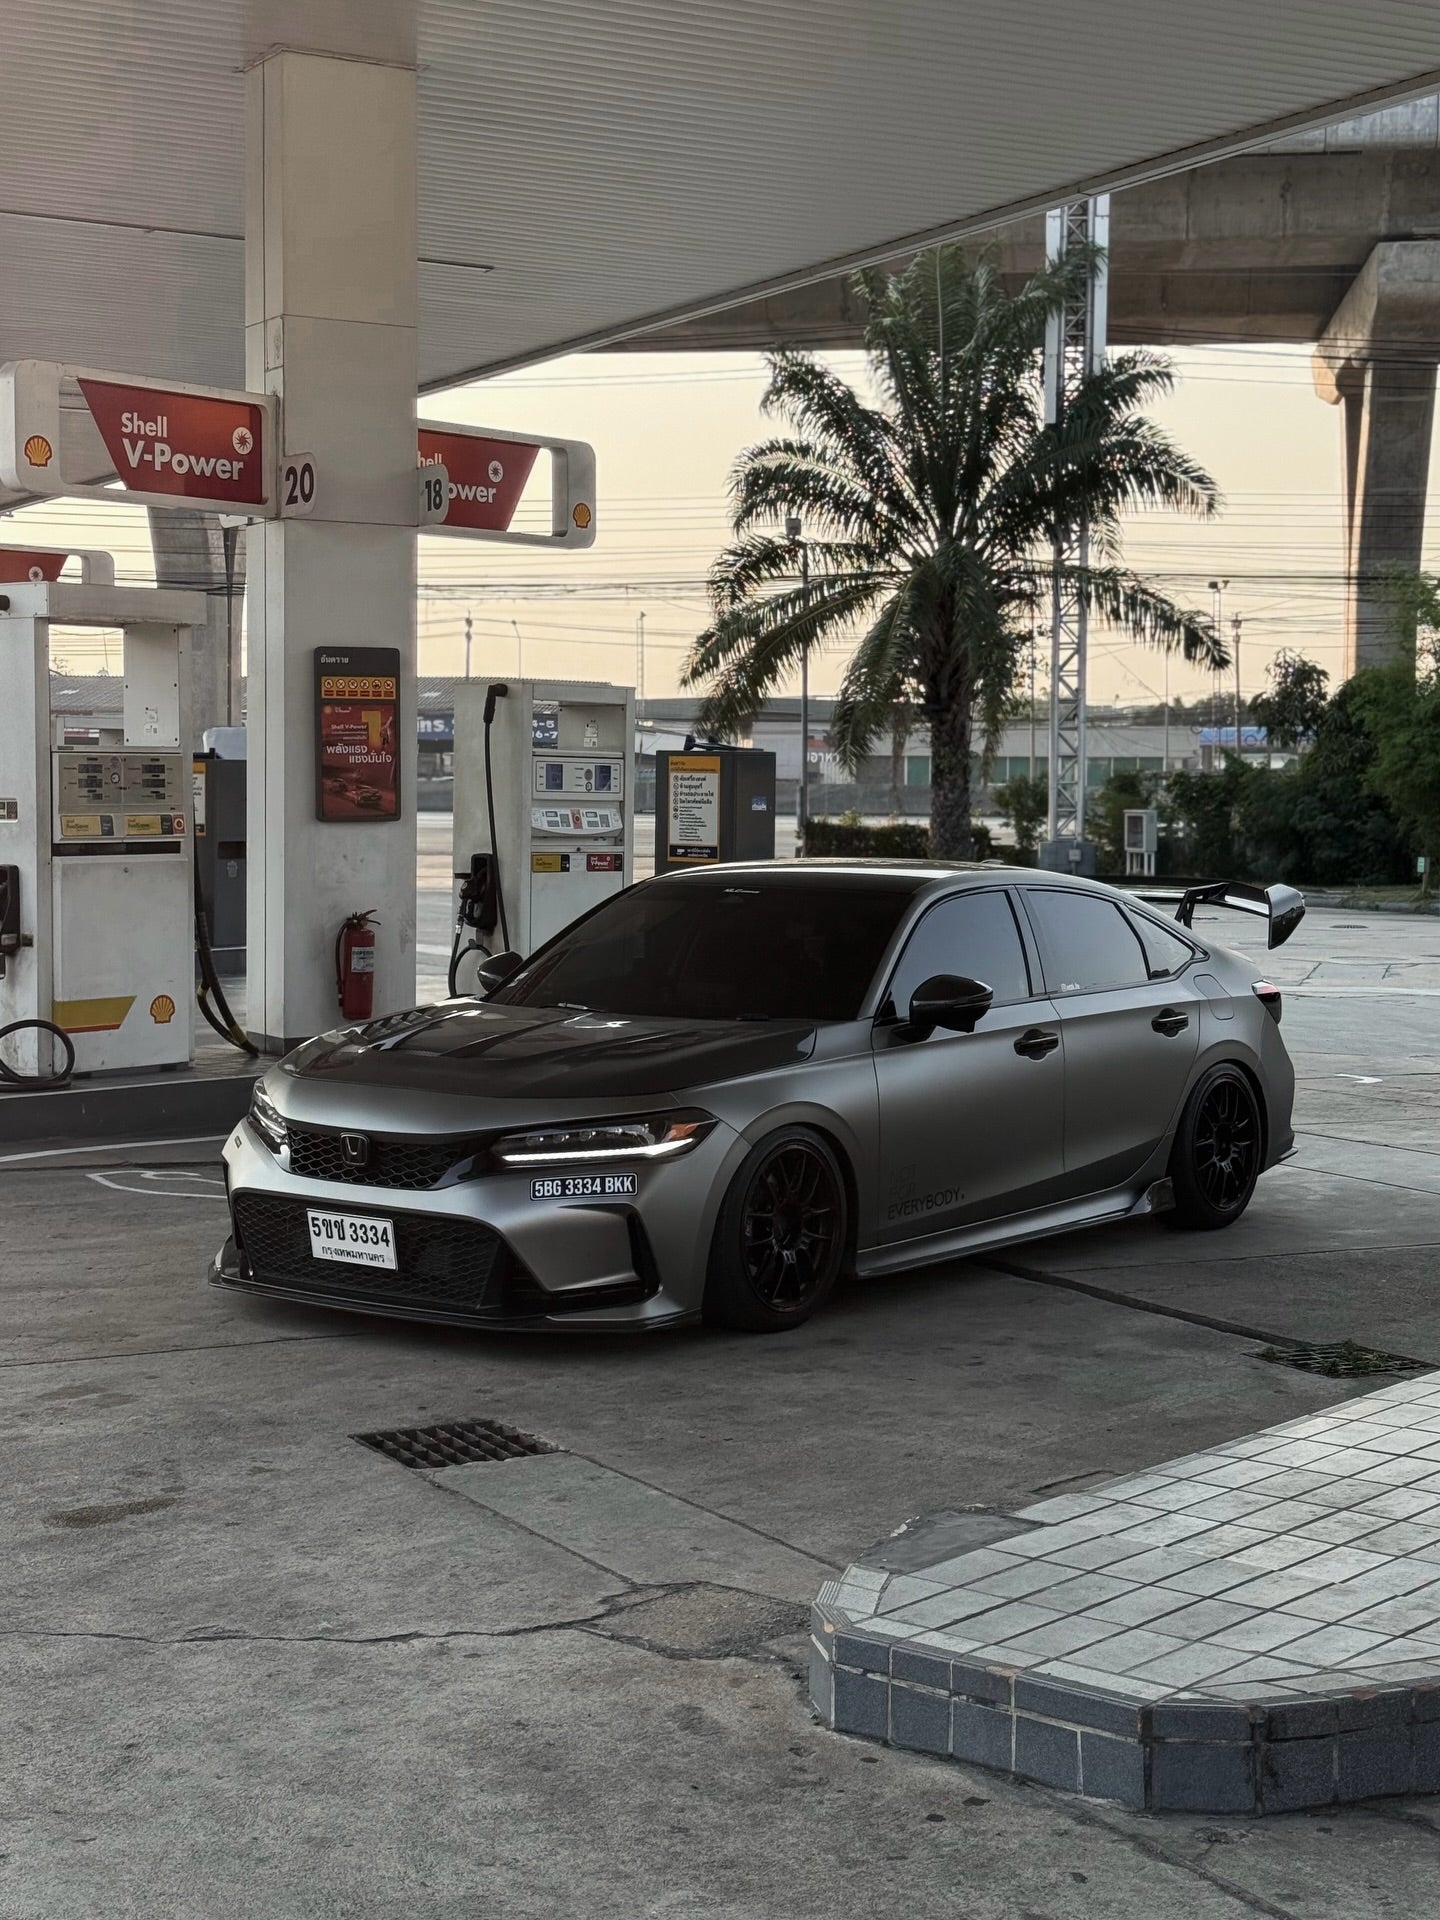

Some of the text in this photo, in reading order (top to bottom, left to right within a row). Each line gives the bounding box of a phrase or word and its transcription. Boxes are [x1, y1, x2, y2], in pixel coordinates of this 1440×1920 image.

[121, 412, 167, 438] Shell
[122, 438, 244, 481] V-Power
[416, 450, 442, 468] hell
[285, 463, 314, 506] 20
[425, 478, 443, 512] 18
[448, 482, 497, 503] ower
[535, 1176, 633, 1197] 5BG 3334 BKK
[349, 1222, 391, 1248] 3334
[322, 1246, 385, 1263] กรุงเทพมหานคร
